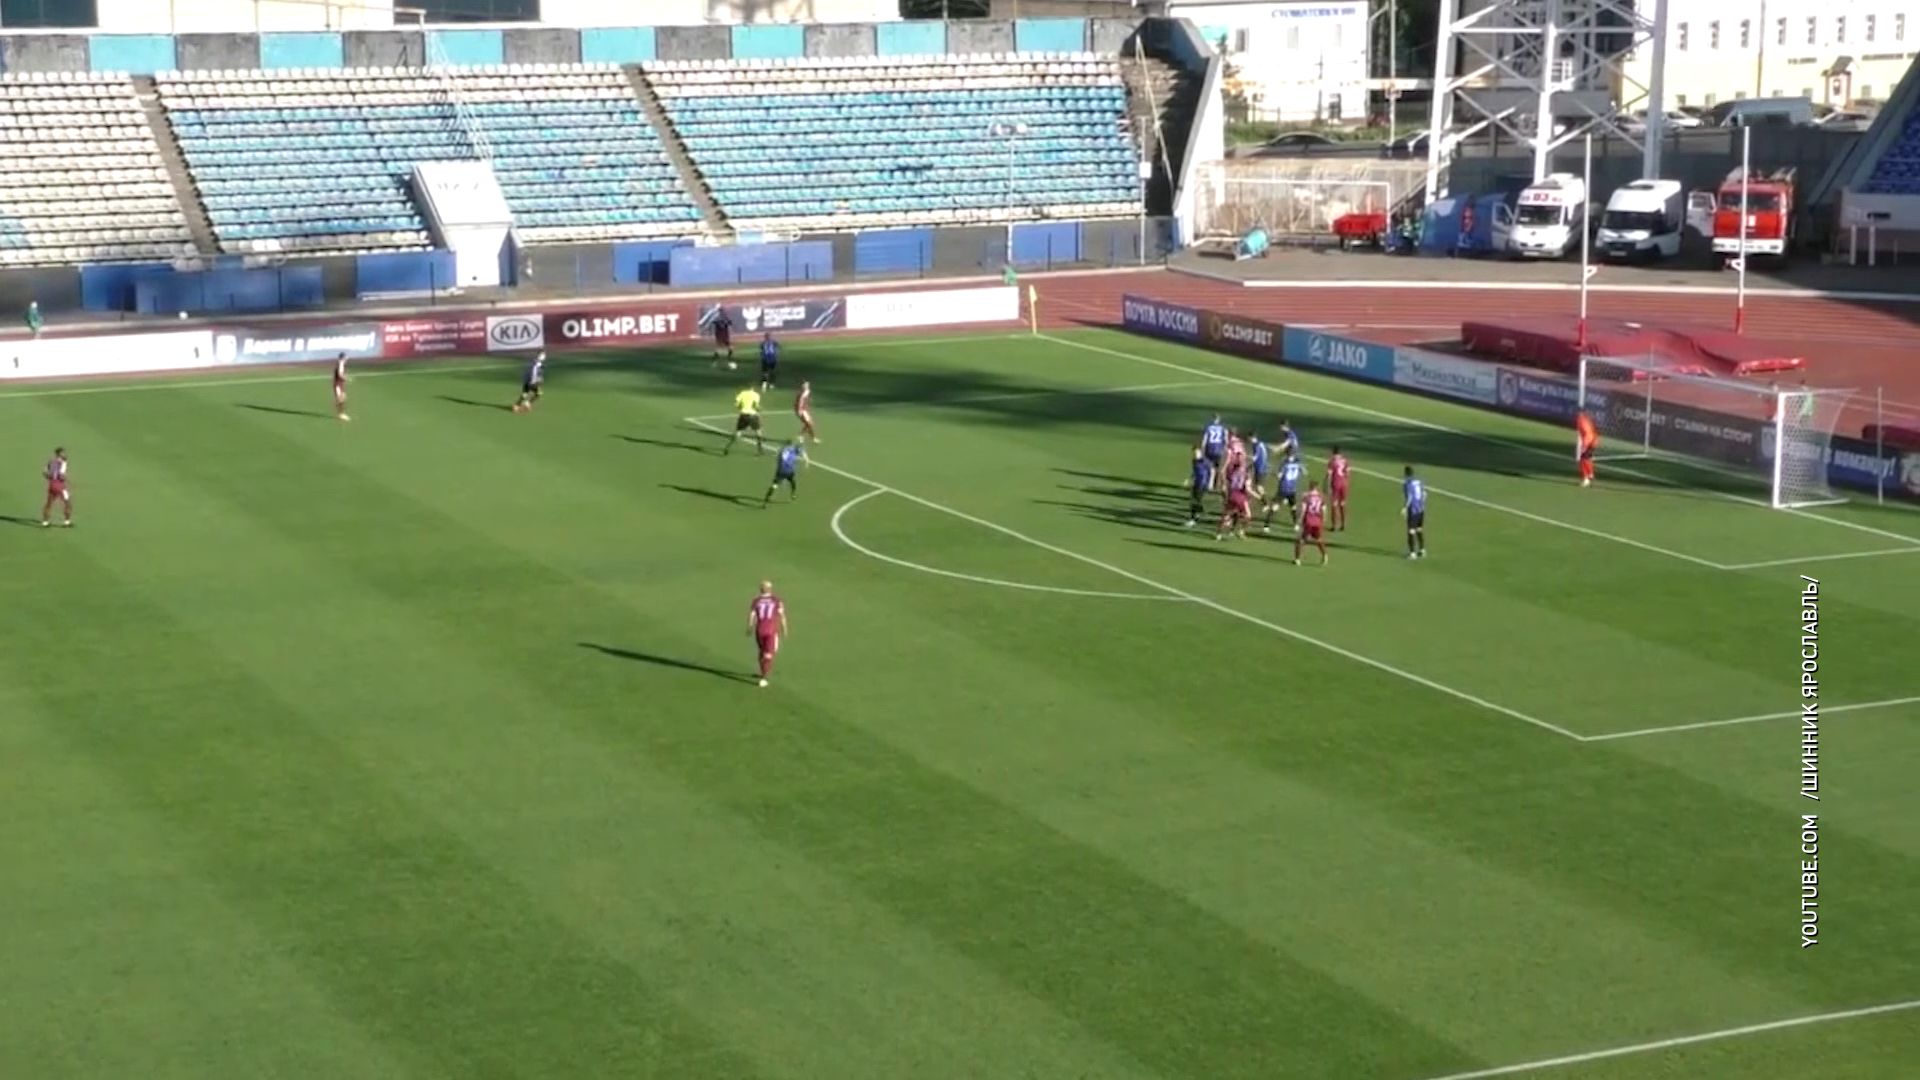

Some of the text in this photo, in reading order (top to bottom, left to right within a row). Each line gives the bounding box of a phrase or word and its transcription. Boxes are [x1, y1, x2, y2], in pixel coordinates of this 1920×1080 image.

[561, 314, 680, 338] OLIMP.BET
[1125, 300, 1198, 334] ПОЧТА РОССИИ
[499, 325, 531, 340] KIA
[1222, 323, 1273, 346] OLIMP.BET
[1327, 341, 1368, 369] JAKO
